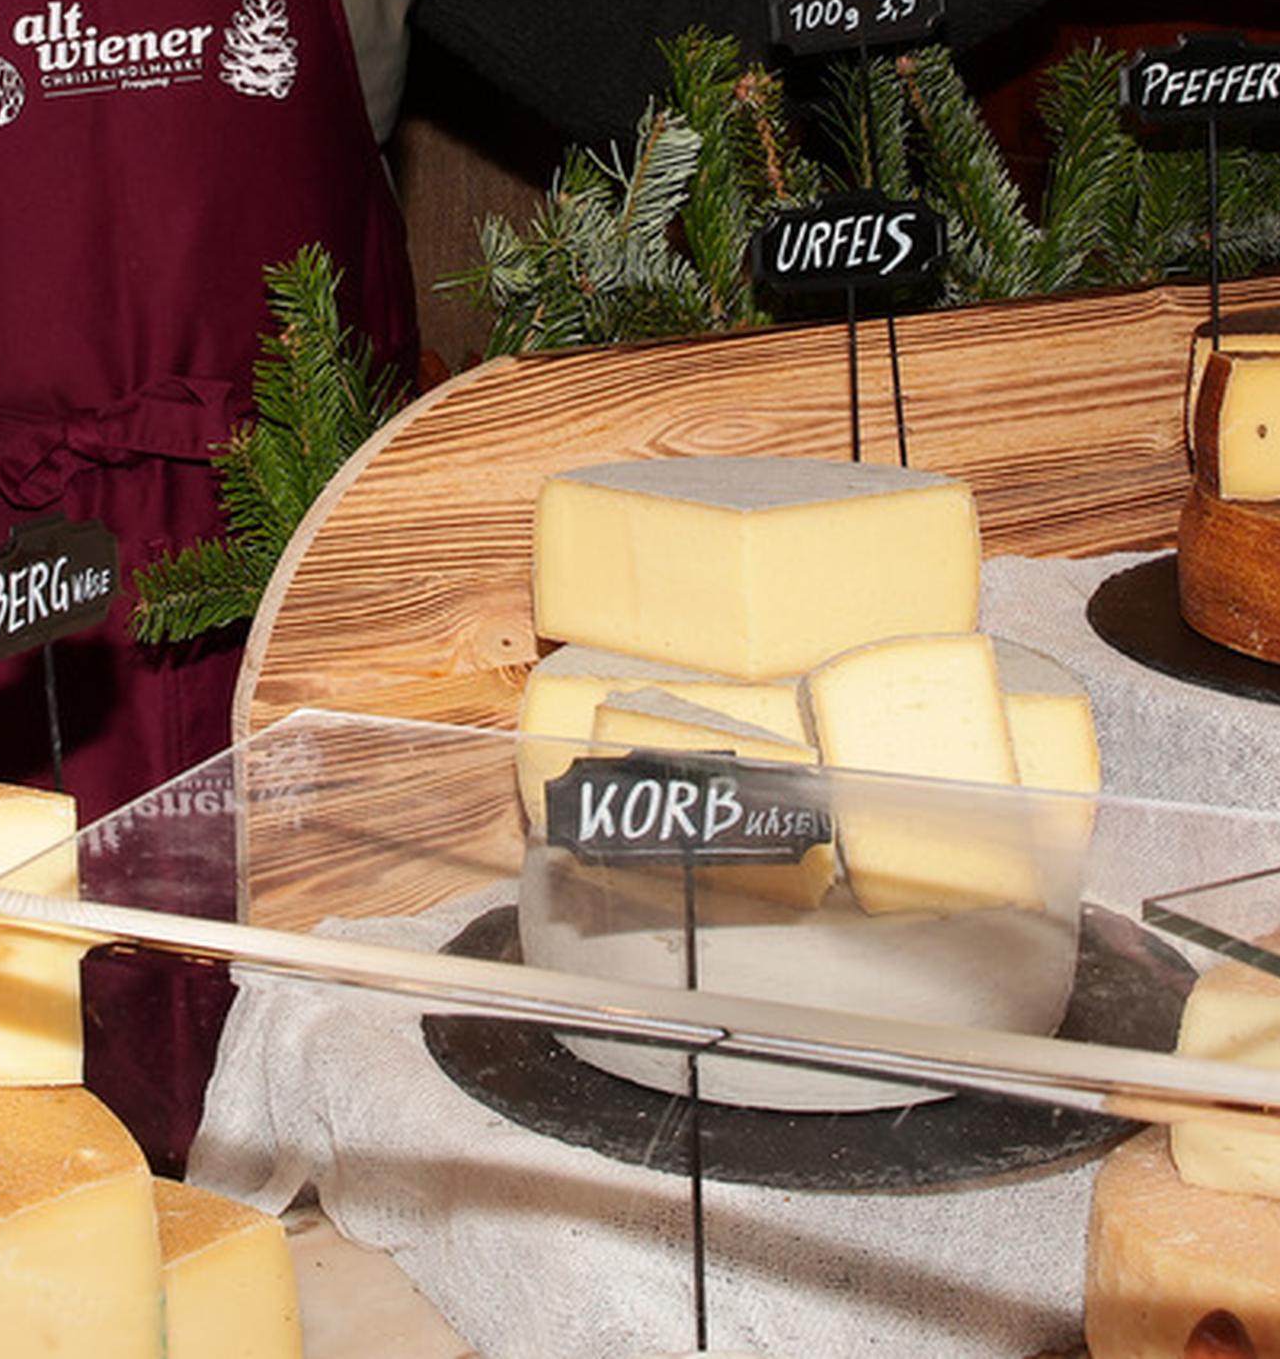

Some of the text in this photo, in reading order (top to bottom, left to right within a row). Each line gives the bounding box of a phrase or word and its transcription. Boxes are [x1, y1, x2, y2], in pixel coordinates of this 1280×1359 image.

[12, 1, 83, 45] alt
[35, 24, 213, 72] wiener
[776, 213, 917, 276] URFELS
